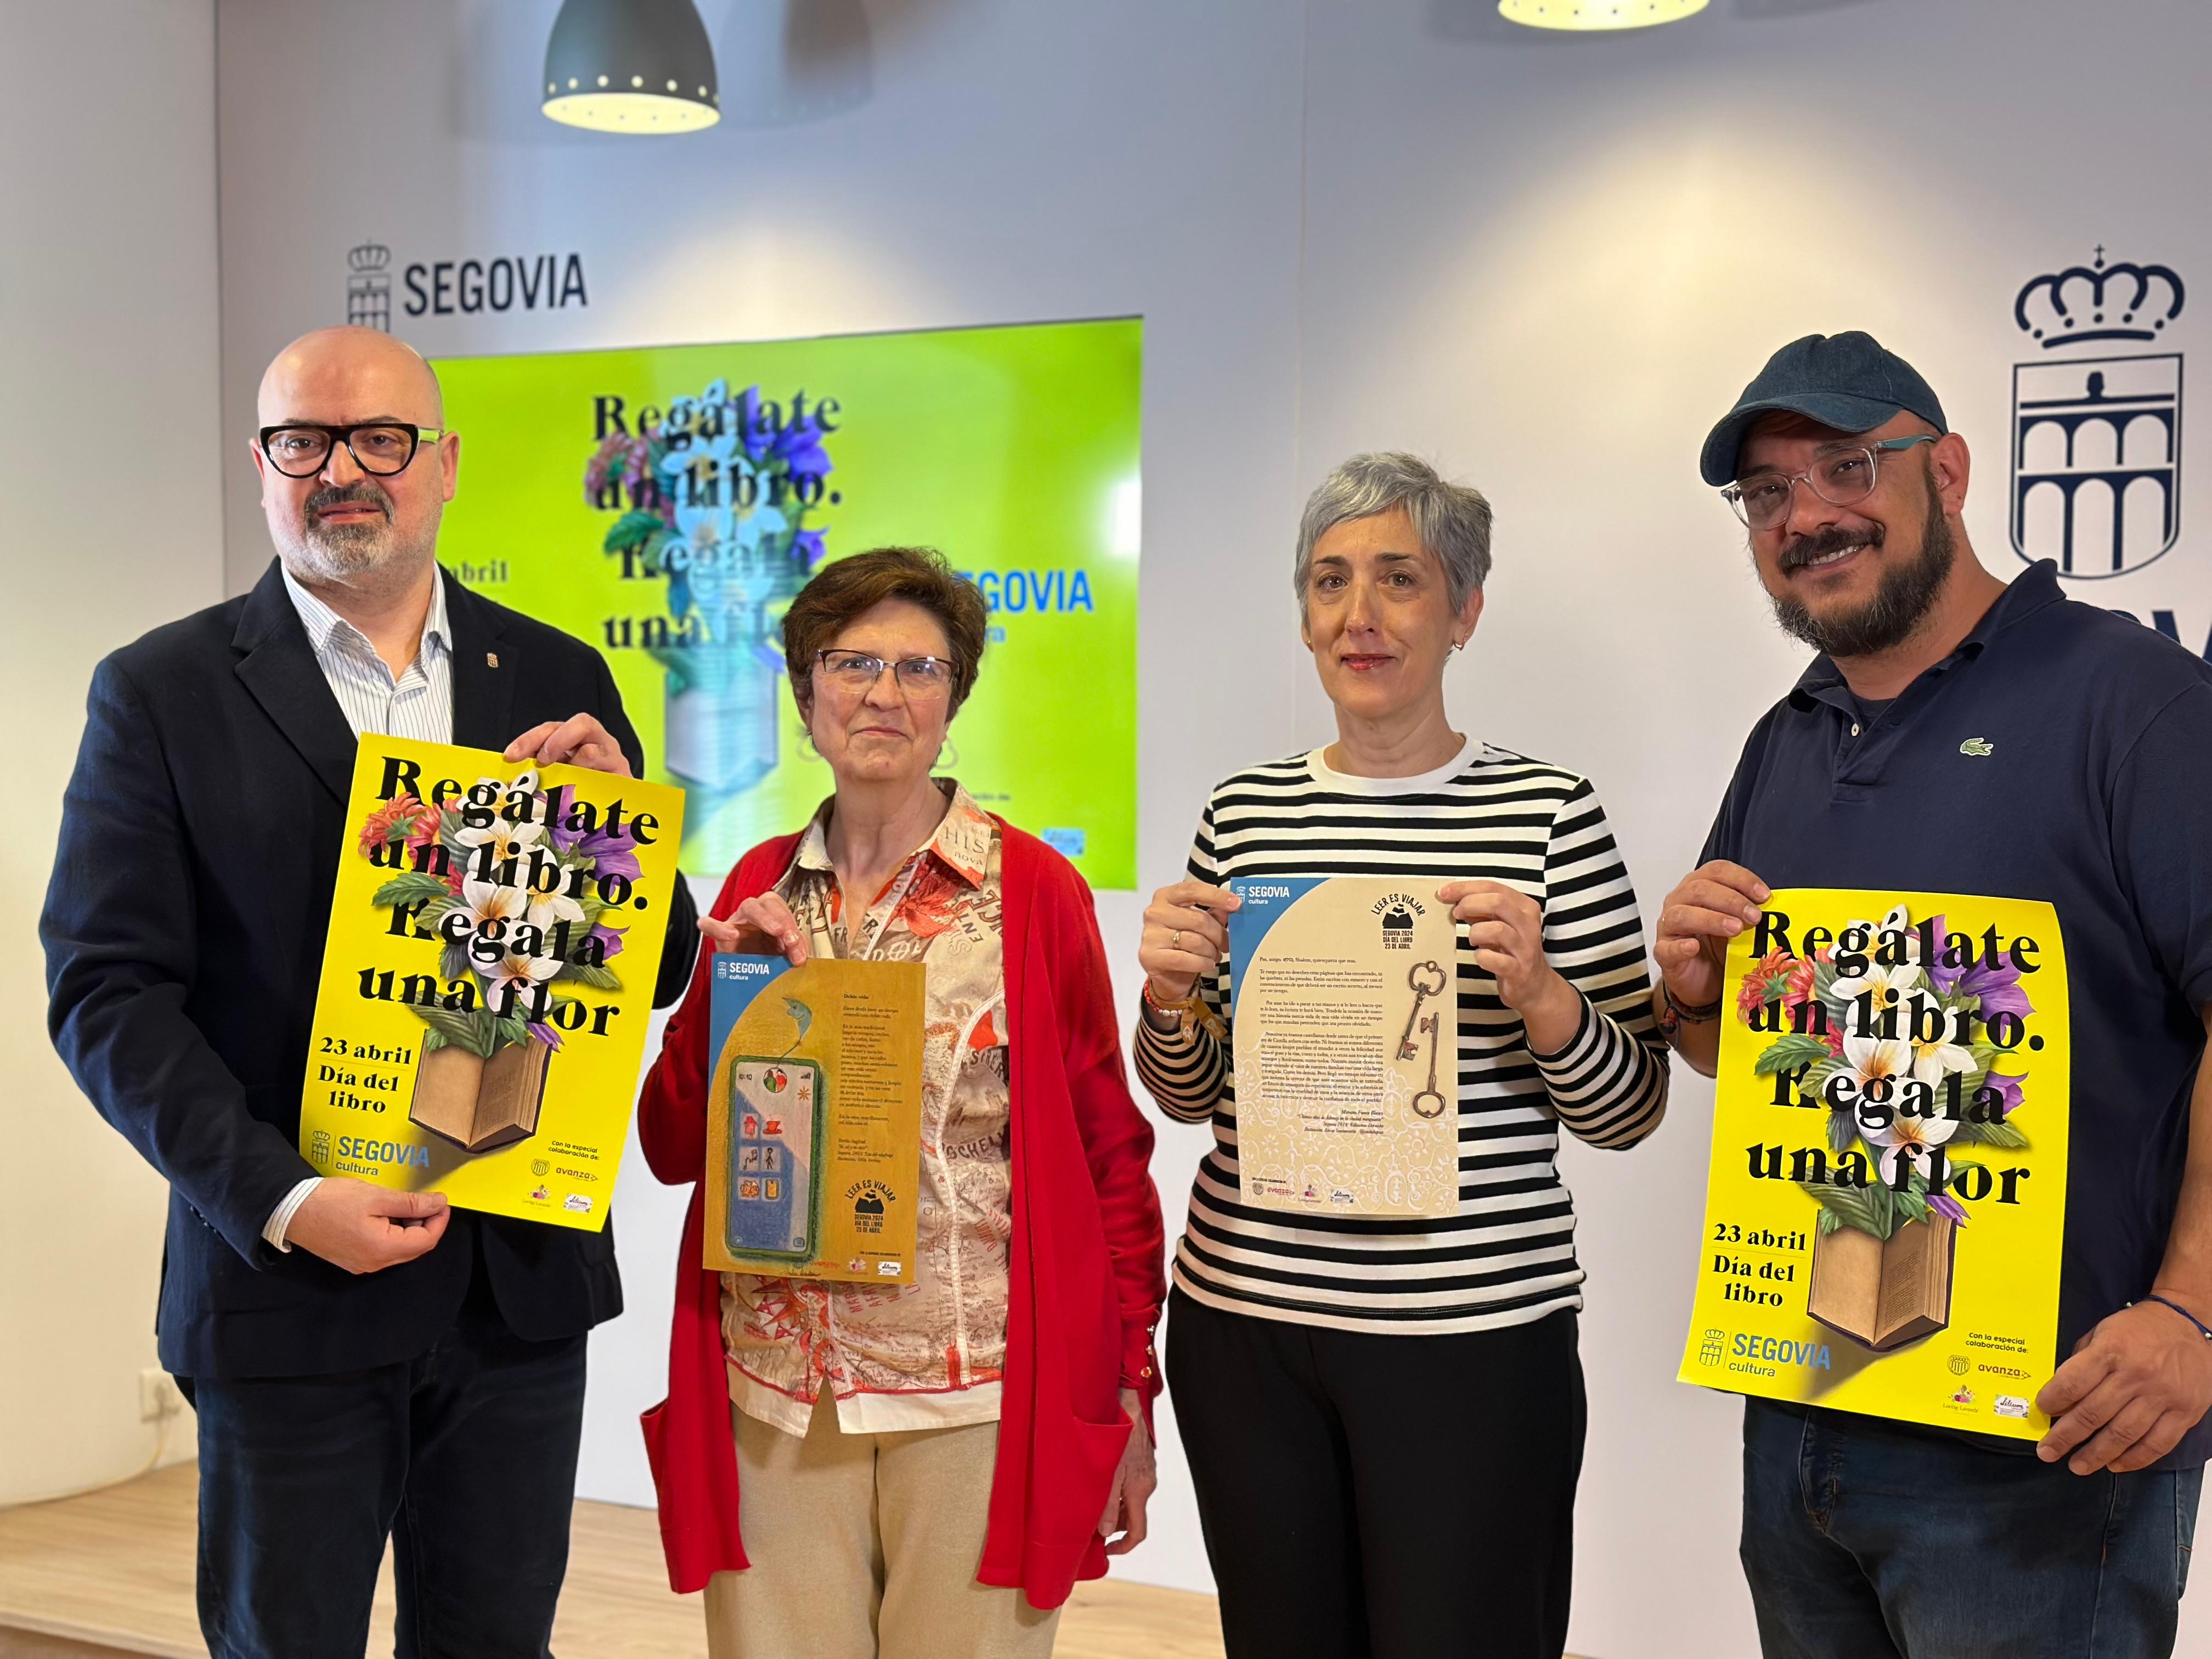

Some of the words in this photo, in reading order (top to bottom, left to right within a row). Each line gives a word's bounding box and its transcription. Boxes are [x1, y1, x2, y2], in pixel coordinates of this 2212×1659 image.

[403, 252, 587, 317] SEGOVIA
[591, 384, 842, 451] Regálate
[683, 460, 842, 508] libro.
[375, 755, 659, 845] Regálate
[954, 850, 984, 866] nova
[369, 838, 450, 876] un
[473, 840, 648, 911] libro.
[1248, 886, 1290, 898] SEGOVIA
[1370, 897, 1390, 915] LEER
[1389, 893, 1399, 903] ES
[1402, 893, 1426, 916] VIAJAR
[385, 896, 607, 969] Regala
[1747, 906, 2041, 979] Regálate
[729, 962, 770, 975] SEGOVIA
[357, 966, 476, 1014] una
[494, 975, 620, 1037] flor
[1748, 994, 1830, 1036] un
[1853, 988, 2045, 1052] libro.
[320, 1036, 348, 1056] 23
[353, 1045, 411, 1065] abril
[318, 1065, 357, 1086] Día
[363, 1073, 399, 1092] del
[329, 1090, 386, 1114] libro
[1769, 1061, 2007, 1130] Regala
[337, 1136, 430, 1168] SEGOVIA
[548, 1147, 589, 1159] colaboración
[572, 1144, 598, 1154] especial
[335, 1161, 379, 1176] cultura
[556, 1167, 590, 1180] avanza
[1746, 1141, 1867, 1189] una
[1892, 1142, 2032, 1204] flor
[845, 1182, 862, 1199] LEER
[862, 1179, 872, 1189] ES
[874, 1180, 896, 1203] VIAJAR
[1713, 1223, 1741, 1243] 23
[1747, 1228, 1806, 1251] abril
[1712, 1254, 1752, 1277] Día
[1758, 1261, 1795, 1282] del
[1724, 1282, 1784, 1307] libro
[1732, 1333, 1831, 1370] SEGOVIA
[1965, 1340, 2016, 1352] colaboración
[1993, 1336, 2025, 1345] especial
[1729, 1361, 1776, 1377] cultura
[1978, 1364, 2021, 1377] avanza
